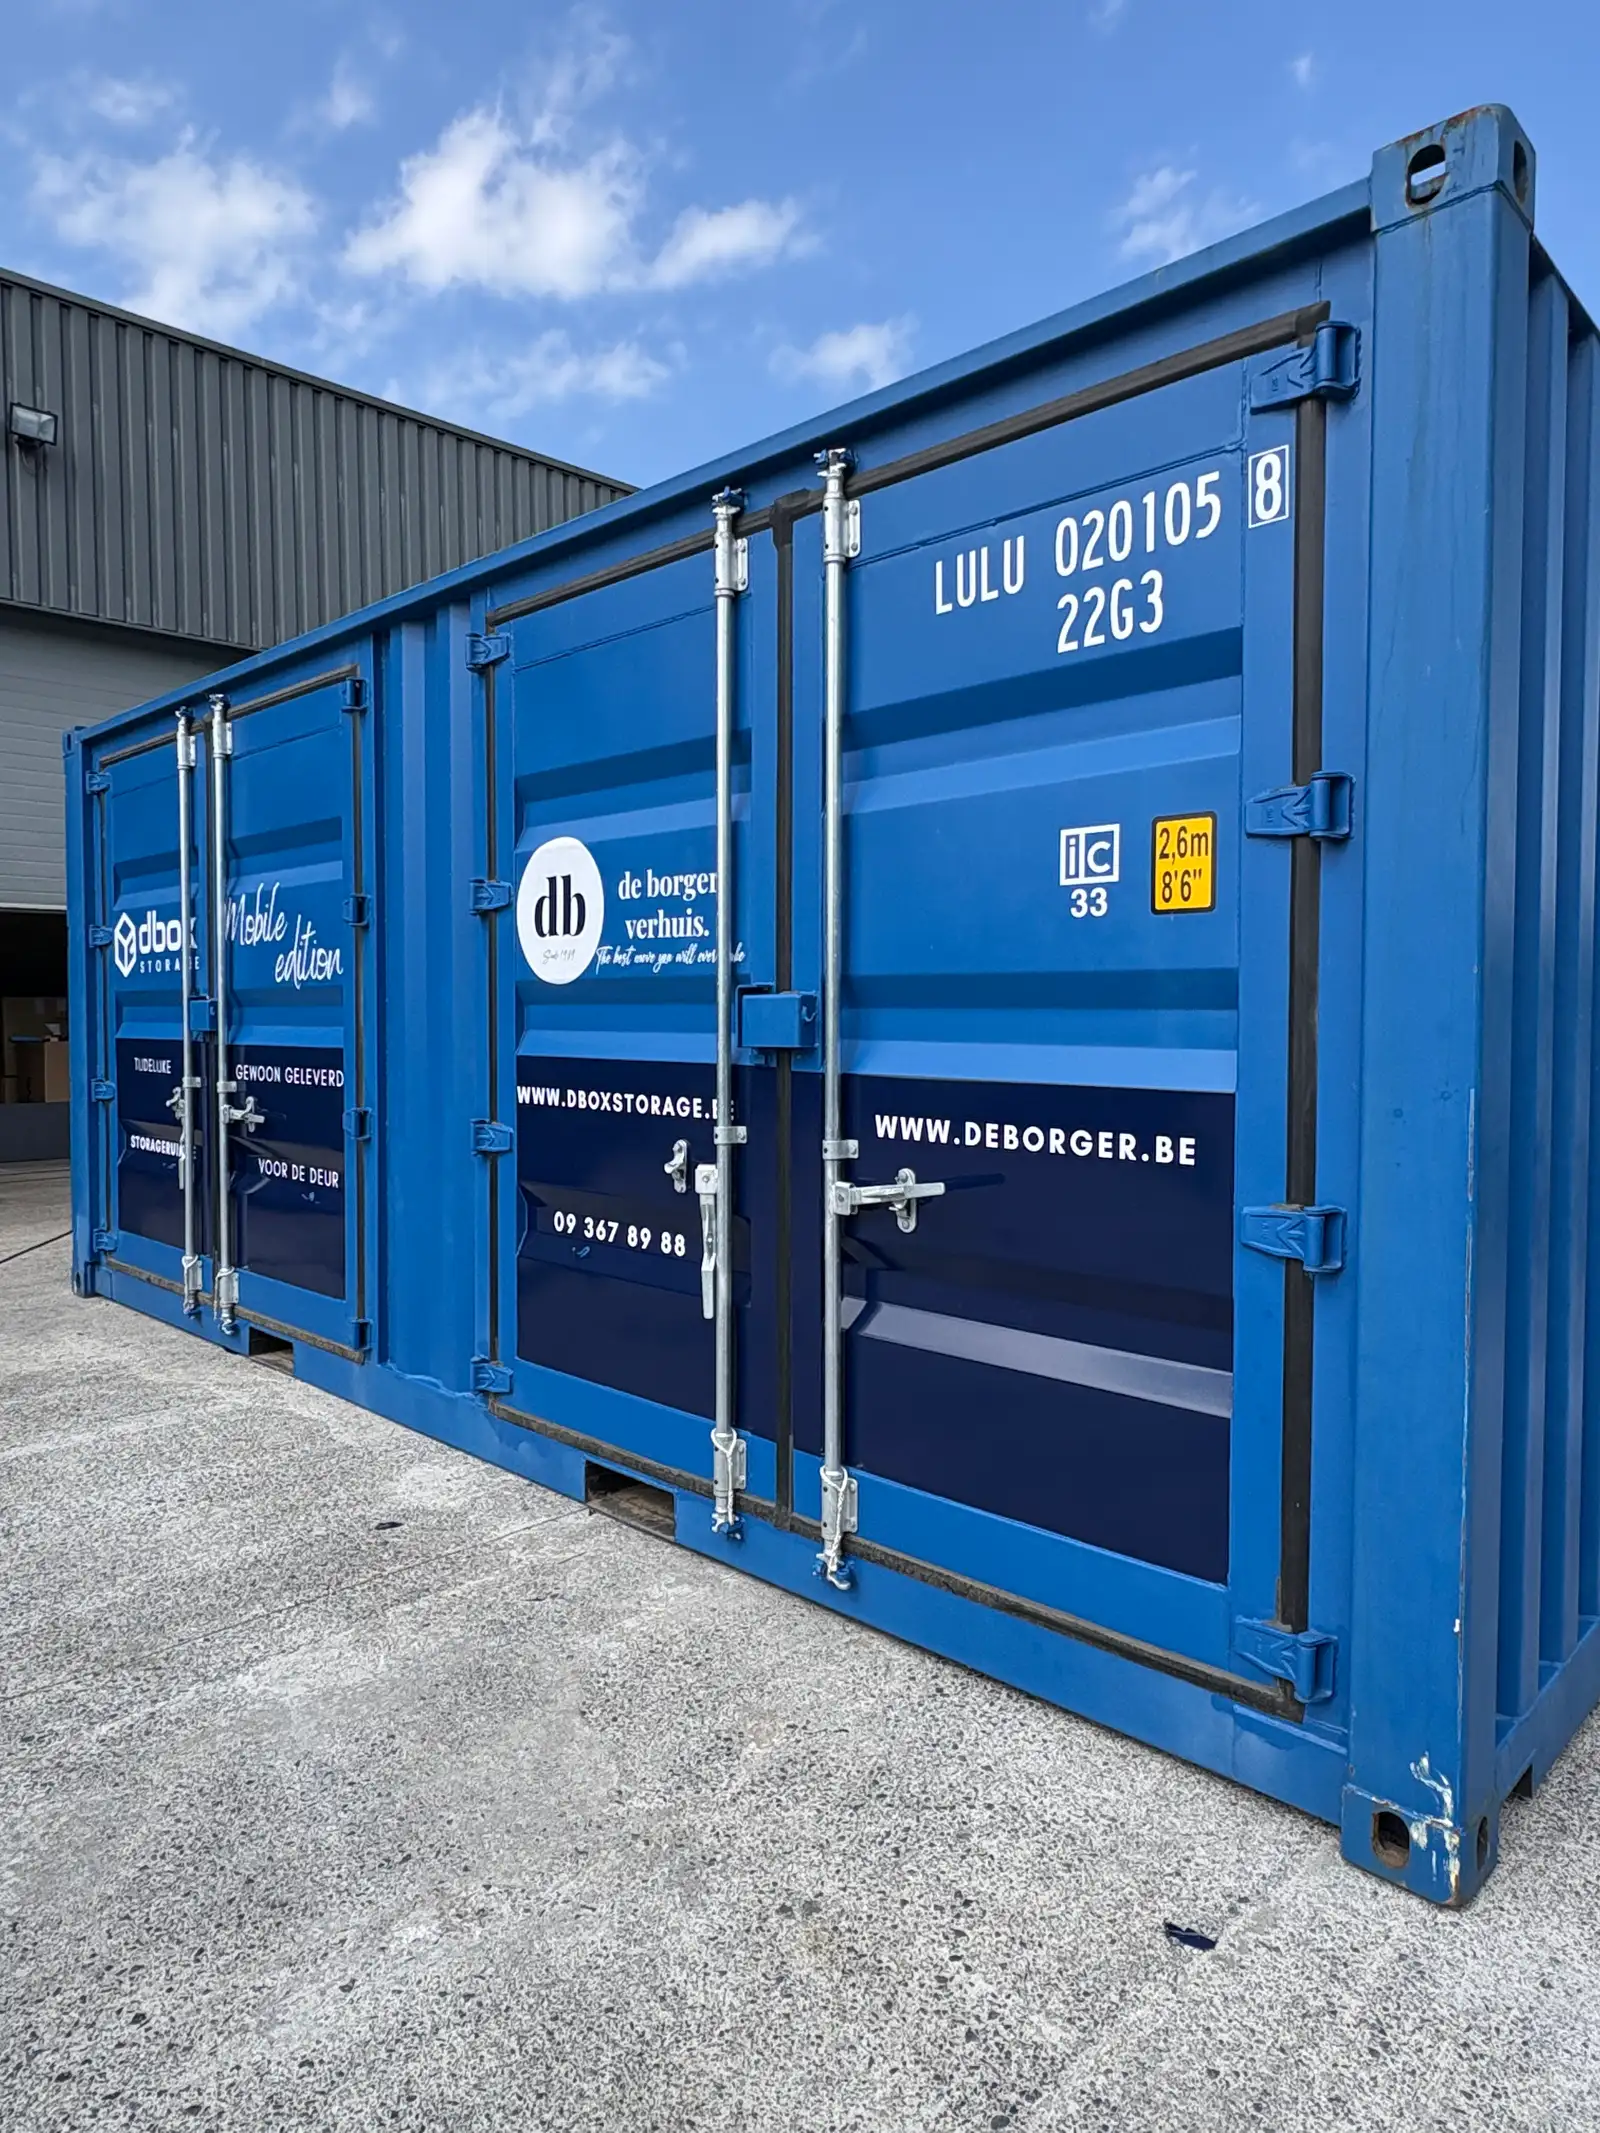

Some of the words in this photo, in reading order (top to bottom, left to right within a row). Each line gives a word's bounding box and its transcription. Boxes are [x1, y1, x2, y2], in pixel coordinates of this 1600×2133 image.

[935, 535, 1025, 615] LULU
[1055, 471, 1221, 577] 020105
[1254, 453, 1282, 521] 8
[1057, 569, 1164, 654] 22G3
[1158, 826, 1209, 865] 2,6m
[618, 871, 641, 901] de
[646, 868, 718, 902] borger
[1070, 887, 1108, 918] 33
[224, 882, 288, 946] Mobile
[534, 873, 587, 938] db
[625, 908, 710, 940] verhuis.
[140, 956, 200, 974] STORAE
[275, 914, 343, 990] edition
[594, 945, 613, 975] The
[613, 944, 636, 966] best
[675, 942, 698, 965] will
[235, 1064, 281, 1083] GEWOON
[284, 1067, 344, 1087] GELEVERD
[517, 1085, 734, 1121] WWW.DBOXSTORAGE.
[130, 1134, 197, 1160] STORAGERUI
[874, 1114, 1196, 1166] WWW.DEBORGER.BE
[258, 1158, 288, 1178] VOOR
[291, 1164, 305, 1182] DE
[309, 1167, 339, 1188] DEUR
[553, 1211, 577, 1234] 09
[584, 1217, 619, 1242] 367
[627, 1225, 651, 1250] 89
[660, 1232, 686, 1257] 88
